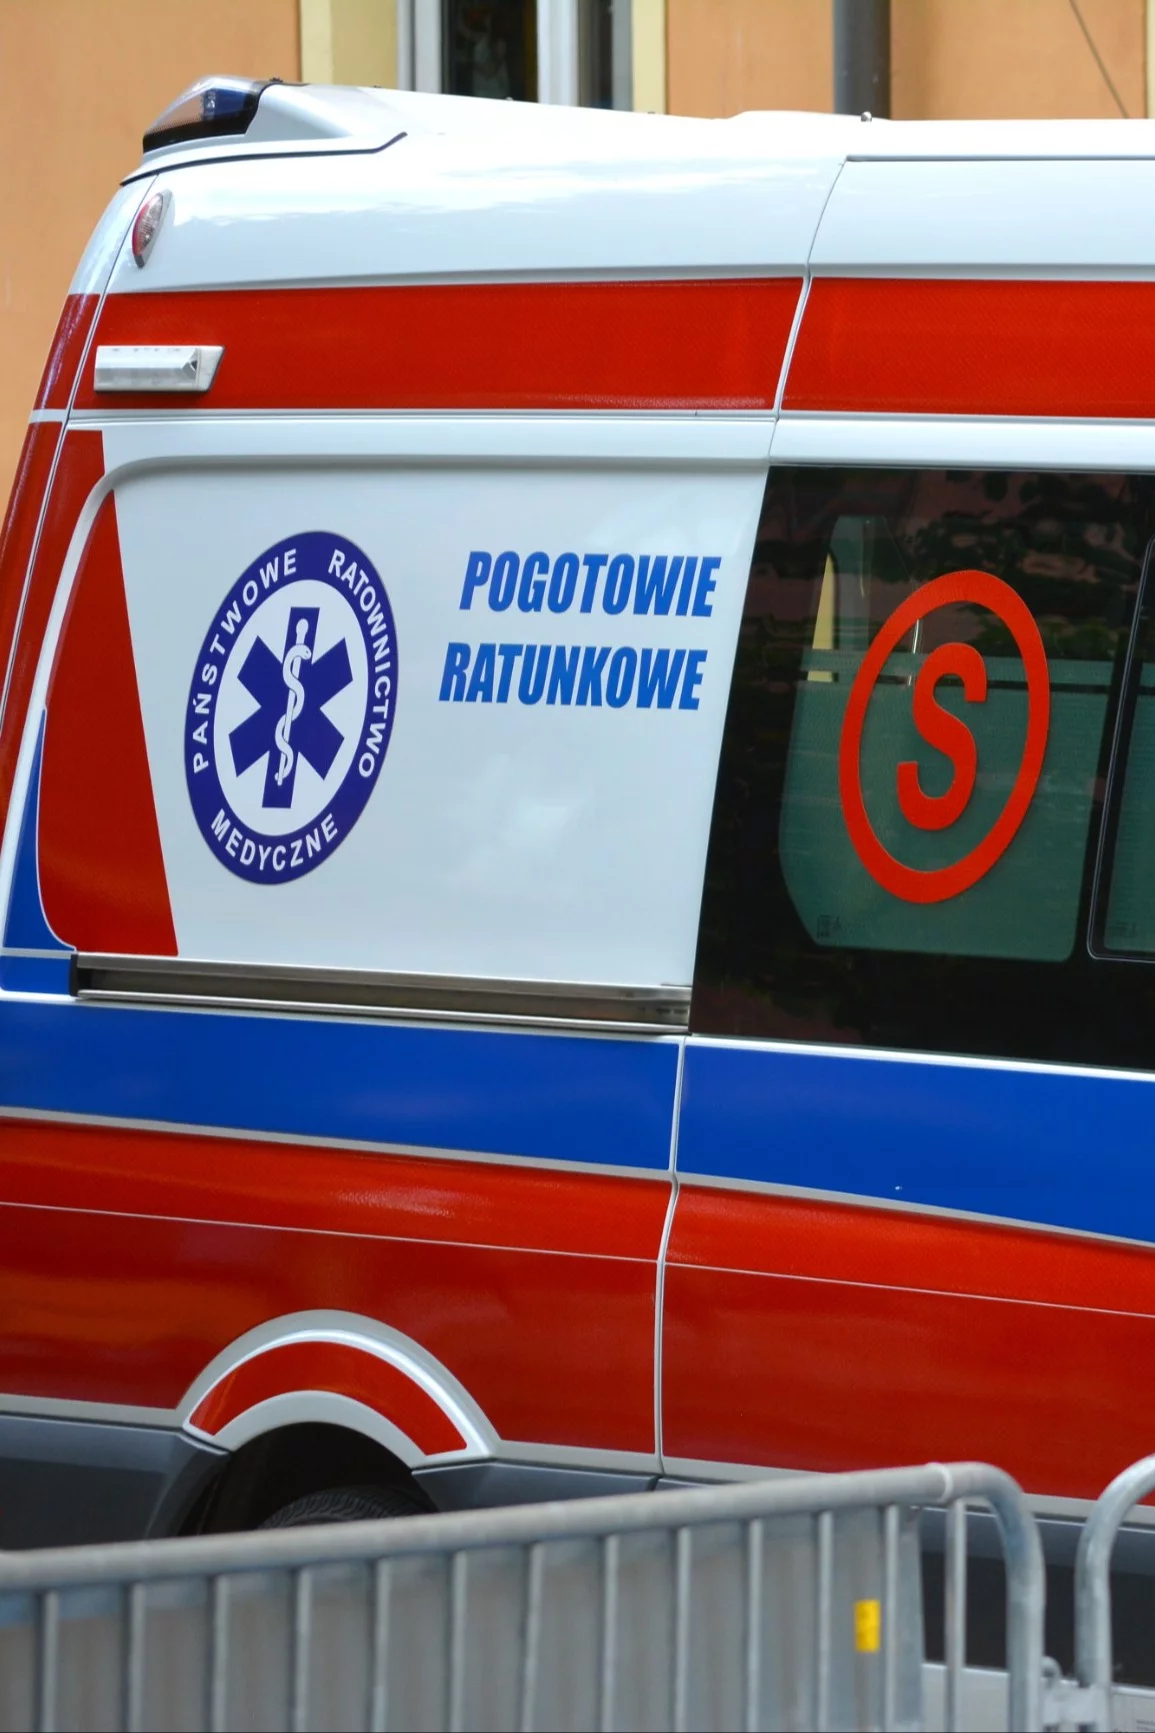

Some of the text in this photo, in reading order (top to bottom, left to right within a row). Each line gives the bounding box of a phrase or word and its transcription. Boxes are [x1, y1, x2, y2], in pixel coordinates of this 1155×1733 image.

[459, 550, 722, 618] POGOTOWIE
[192, 548, 392, 778] PAŃSTWOWE RATOWNICTWO
[438, 641, 709, 711] RATUNKOWE
[896, 642, 988, 831] S
[210, 812, 338, 872] MEDYCZNE
